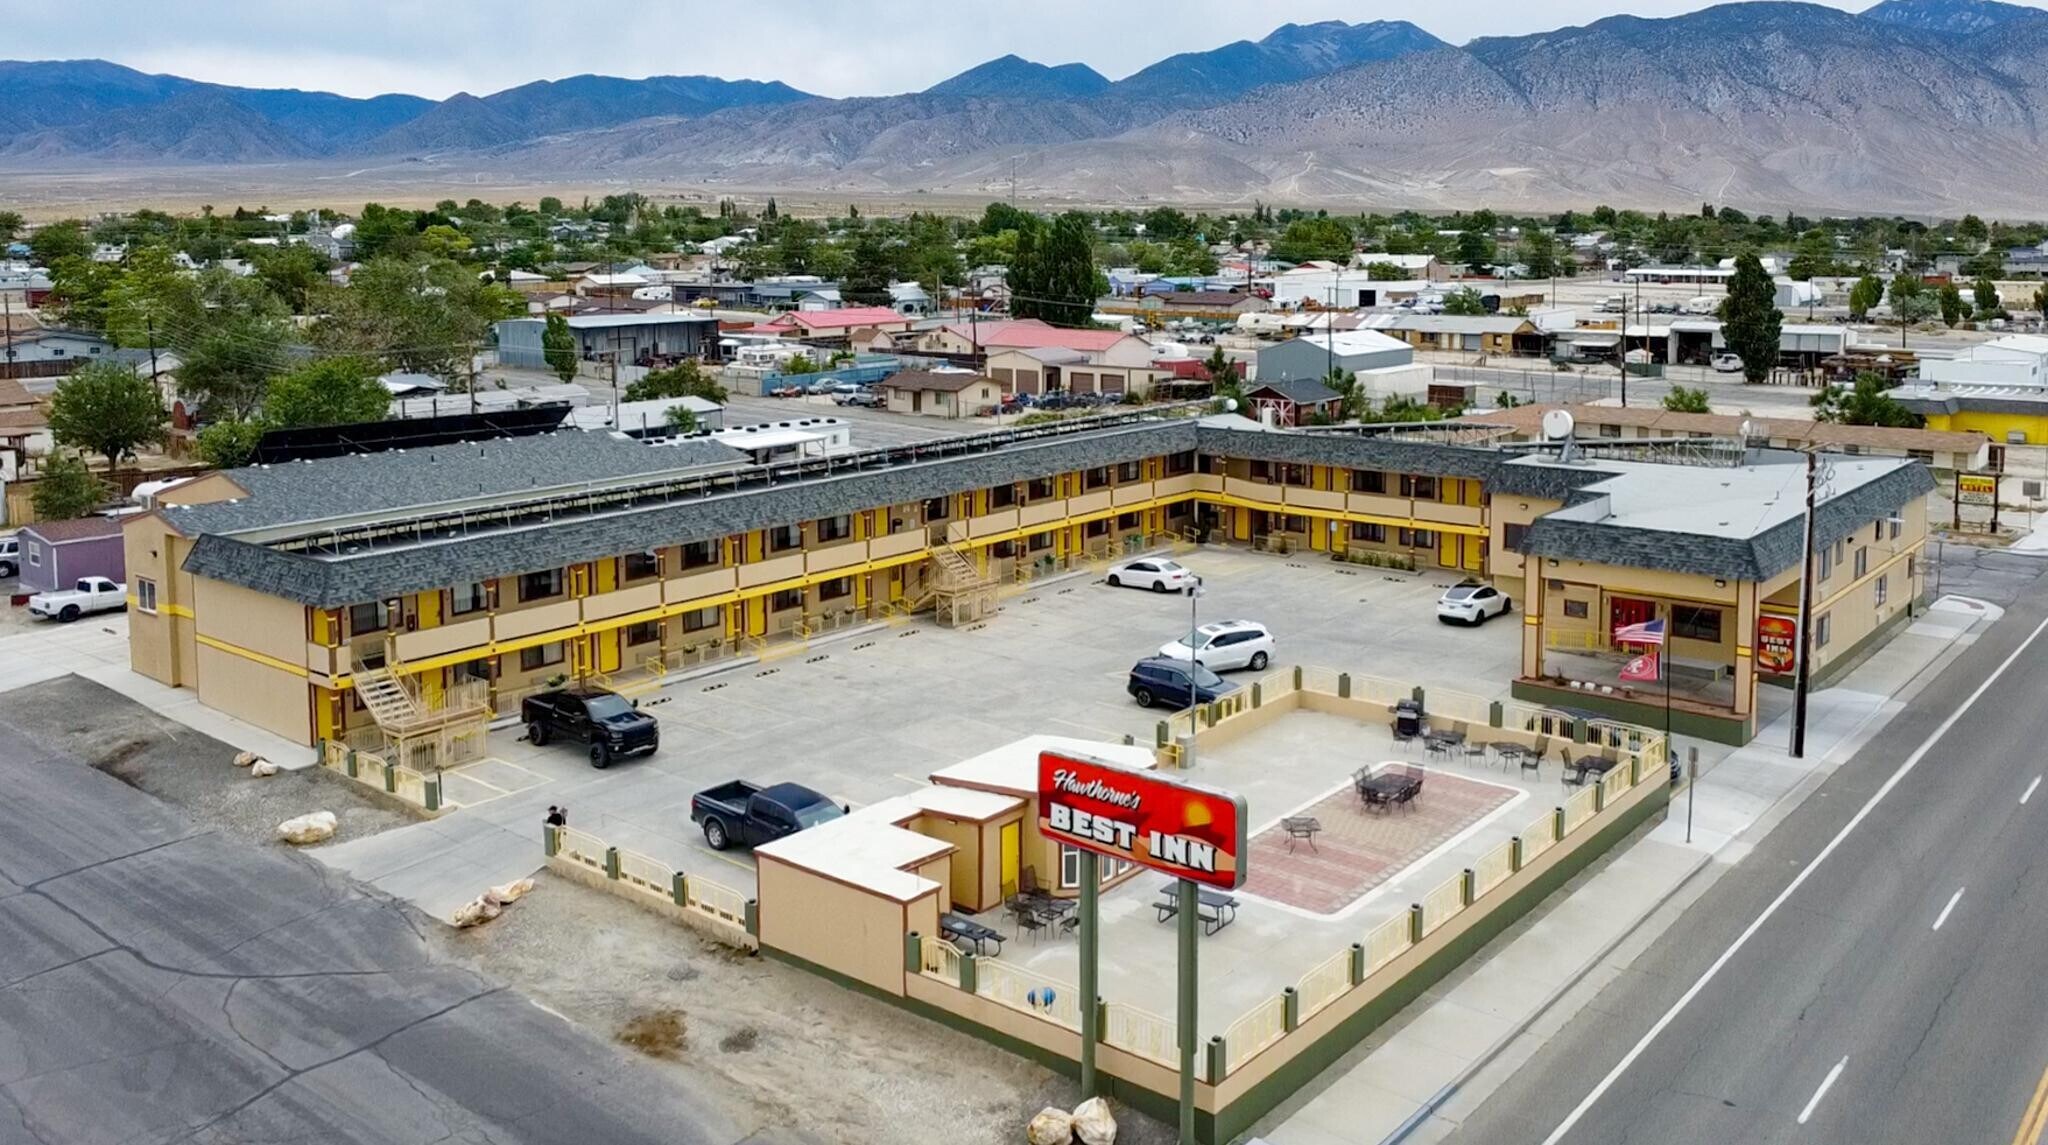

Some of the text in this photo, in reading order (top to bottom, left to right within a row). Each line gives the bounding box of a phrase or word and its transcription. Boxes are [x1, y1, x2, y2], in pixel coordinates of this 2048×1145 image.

[1761, 635, 1792, 646] BEST
[1766, 644, 1787, 653] INN
[1053, 769, 1141, 809] Hawthorne's
[1050, 802, 1216, 873] BEST INN
